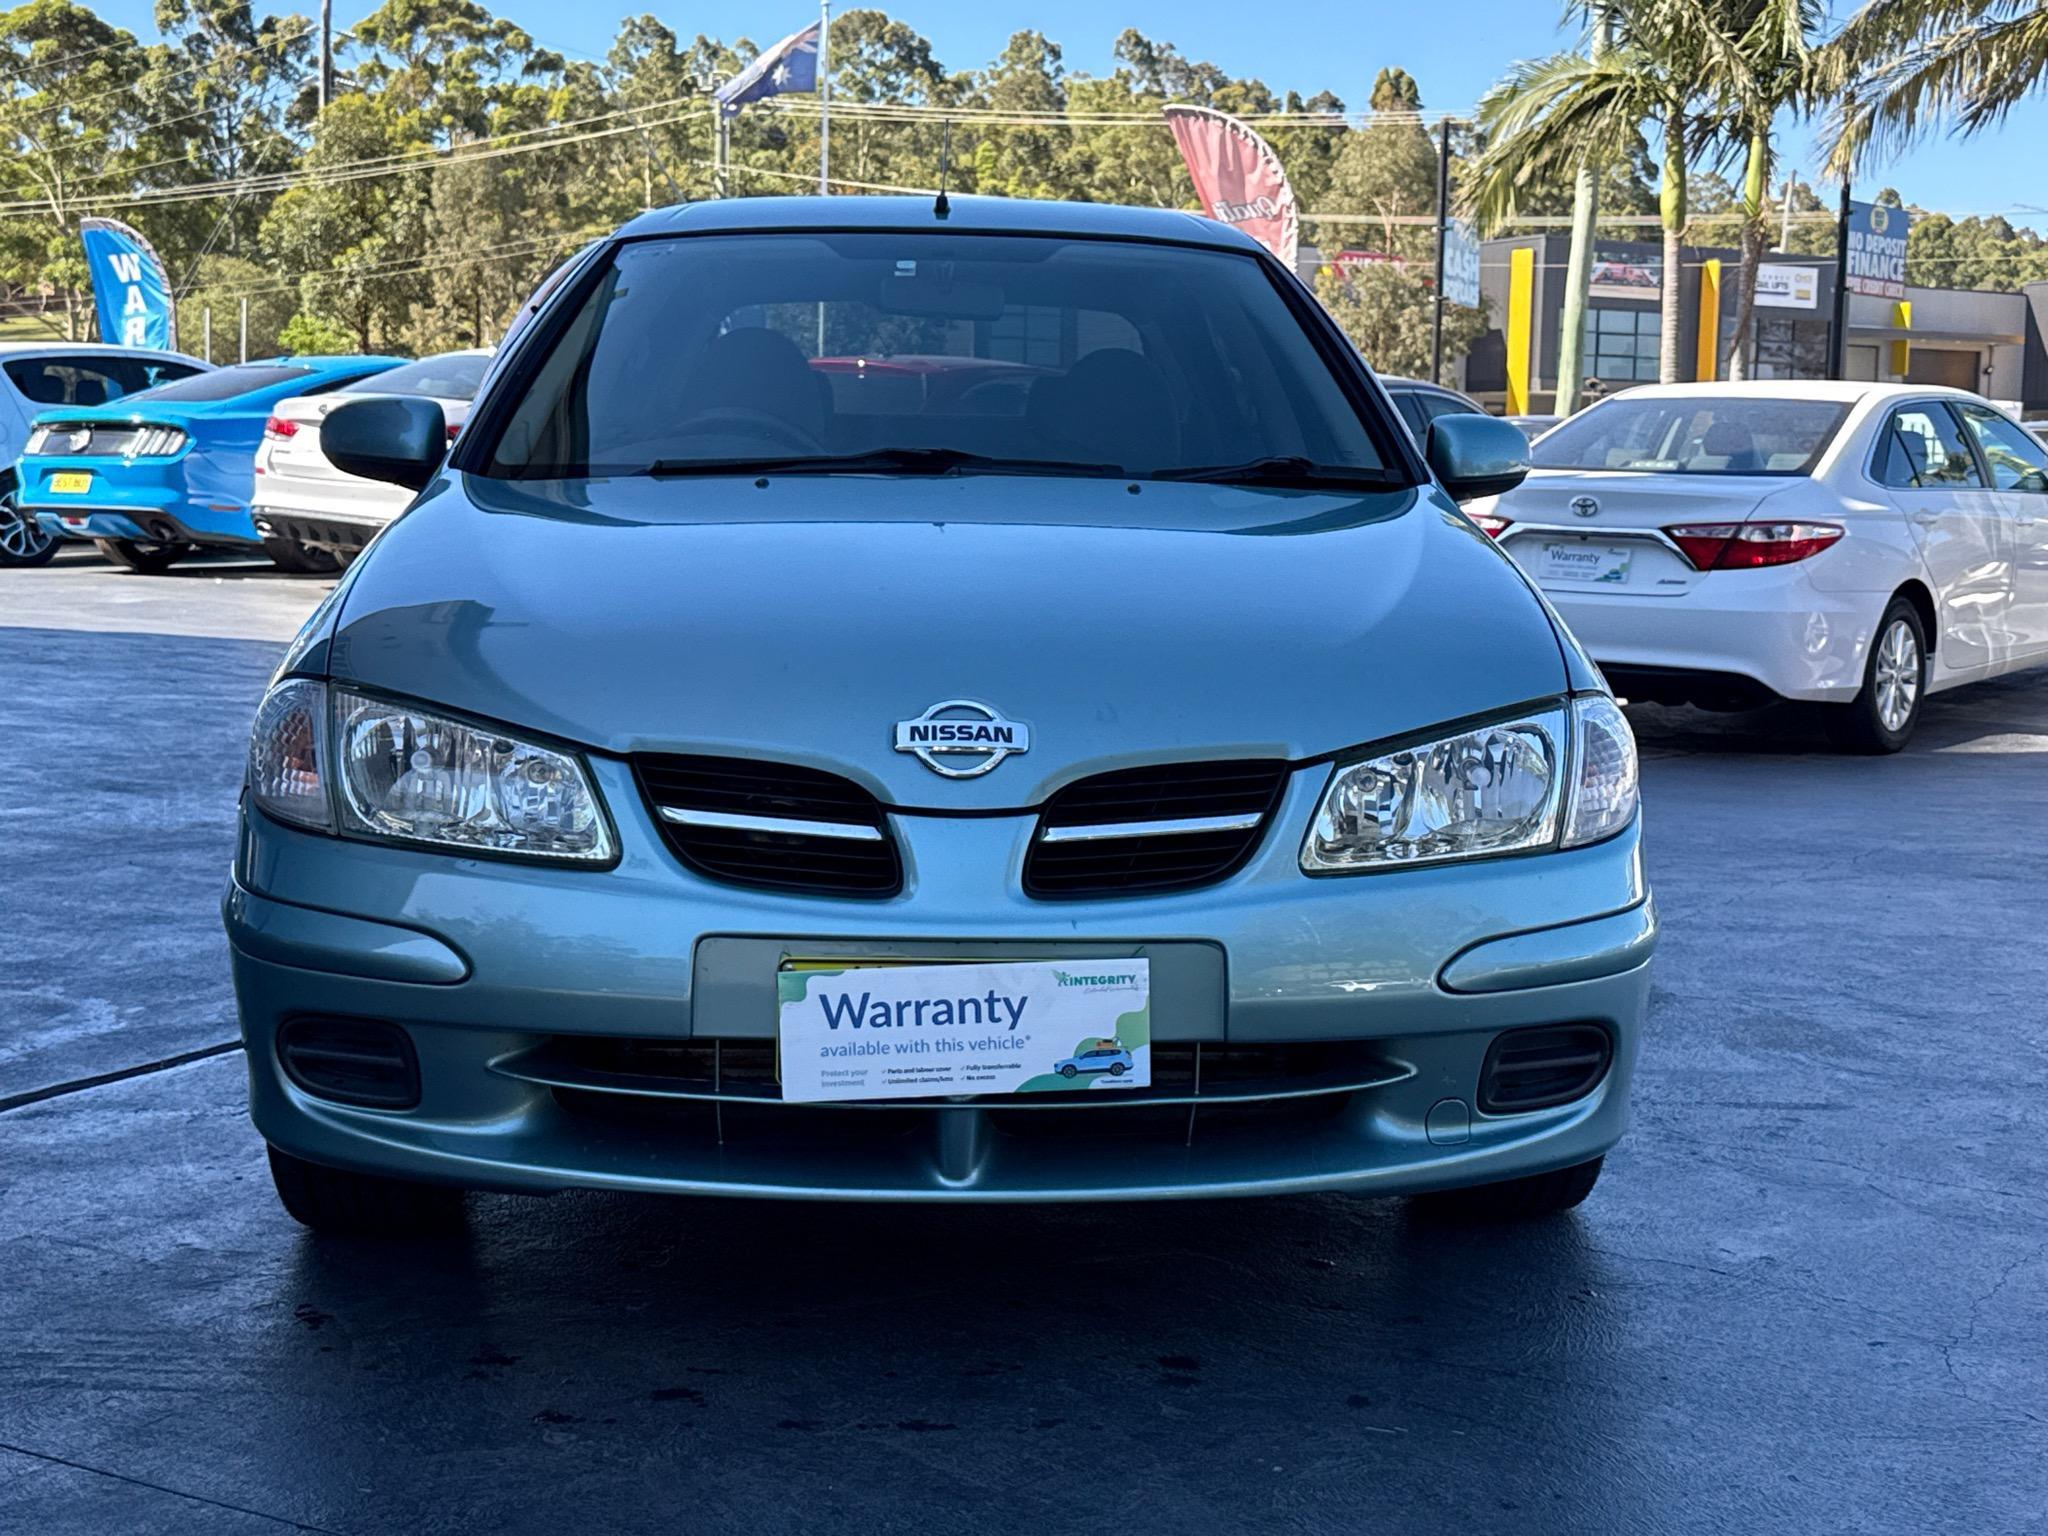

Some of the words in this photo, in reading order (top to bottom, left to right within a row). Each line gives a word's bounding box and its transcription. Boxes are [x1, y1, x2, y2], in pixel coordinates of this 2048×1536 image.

[1866, 234, 1906, 257] DEPOSIT
[1847, 250, 1905, 282] FINANCE
[1551, 550, 1600, 564] Warranty
[910, 725, 1013, 743] NISSAN
[1069, 974, 1136, 987] INTEGRITY
[818, 989, 1028, 1031] Warranty
[820, 1040, 891, 1057] available
[894, 1039, 930, 1054] with
[935, 1037, 965, 1053] this
